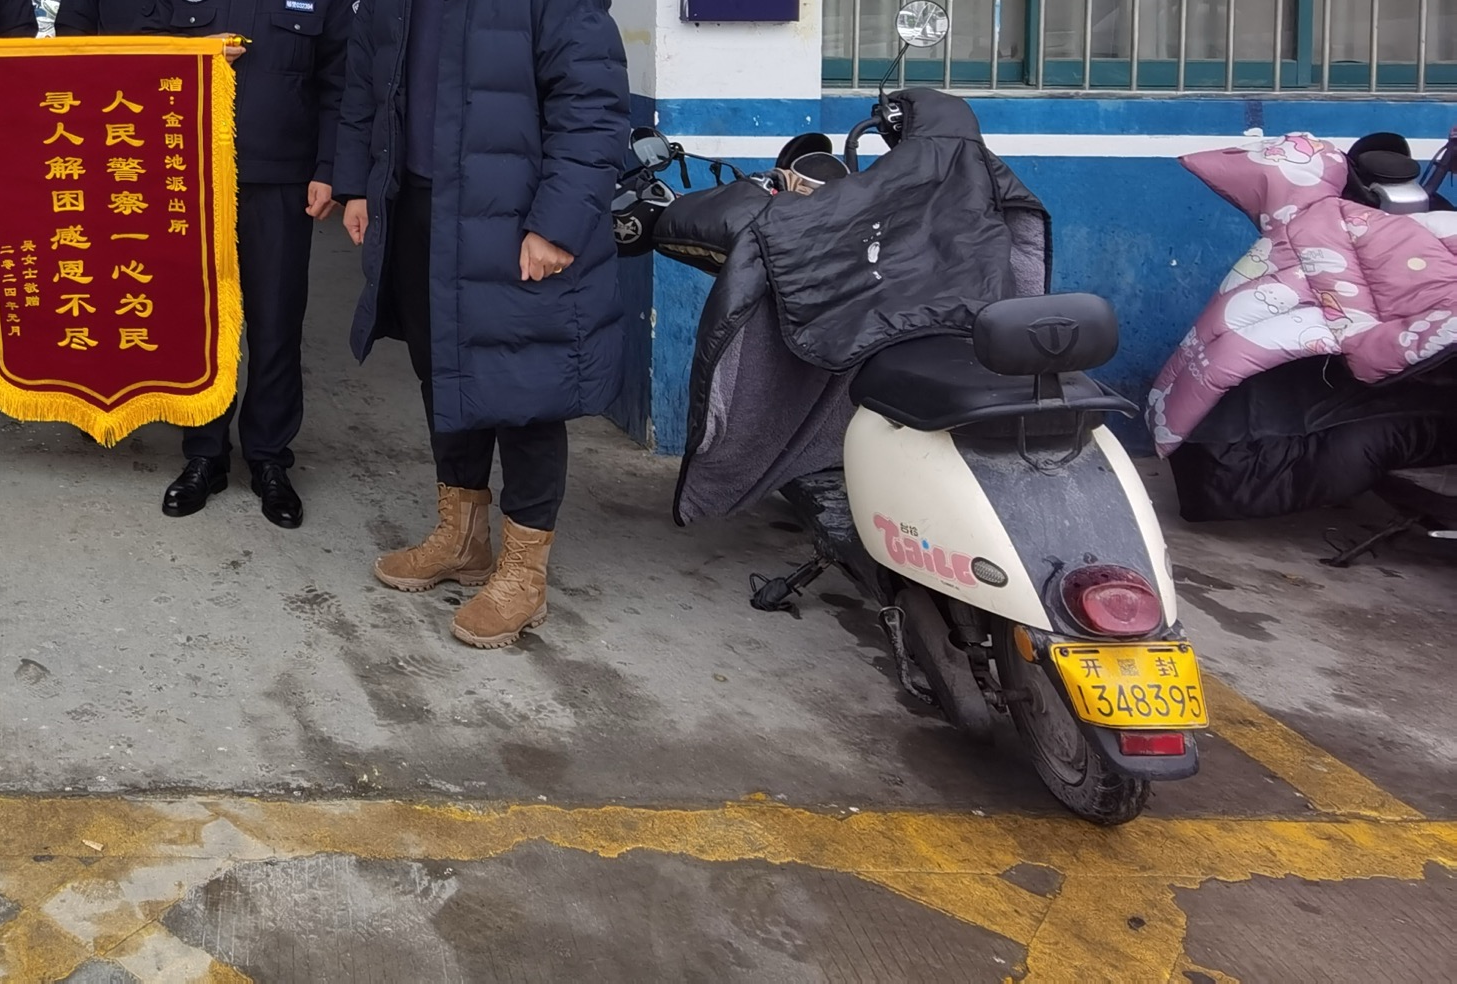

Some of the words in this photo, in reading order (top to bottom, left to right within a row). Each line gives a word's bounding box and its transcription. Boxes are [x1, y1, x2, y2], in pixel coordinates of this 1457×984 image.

[39, 91, 99, 351] 寻人解困感恩不尽
[101, 90, 159, 352] 人民警察一心为民
[1077, 684, 1202, 718] 1348395
